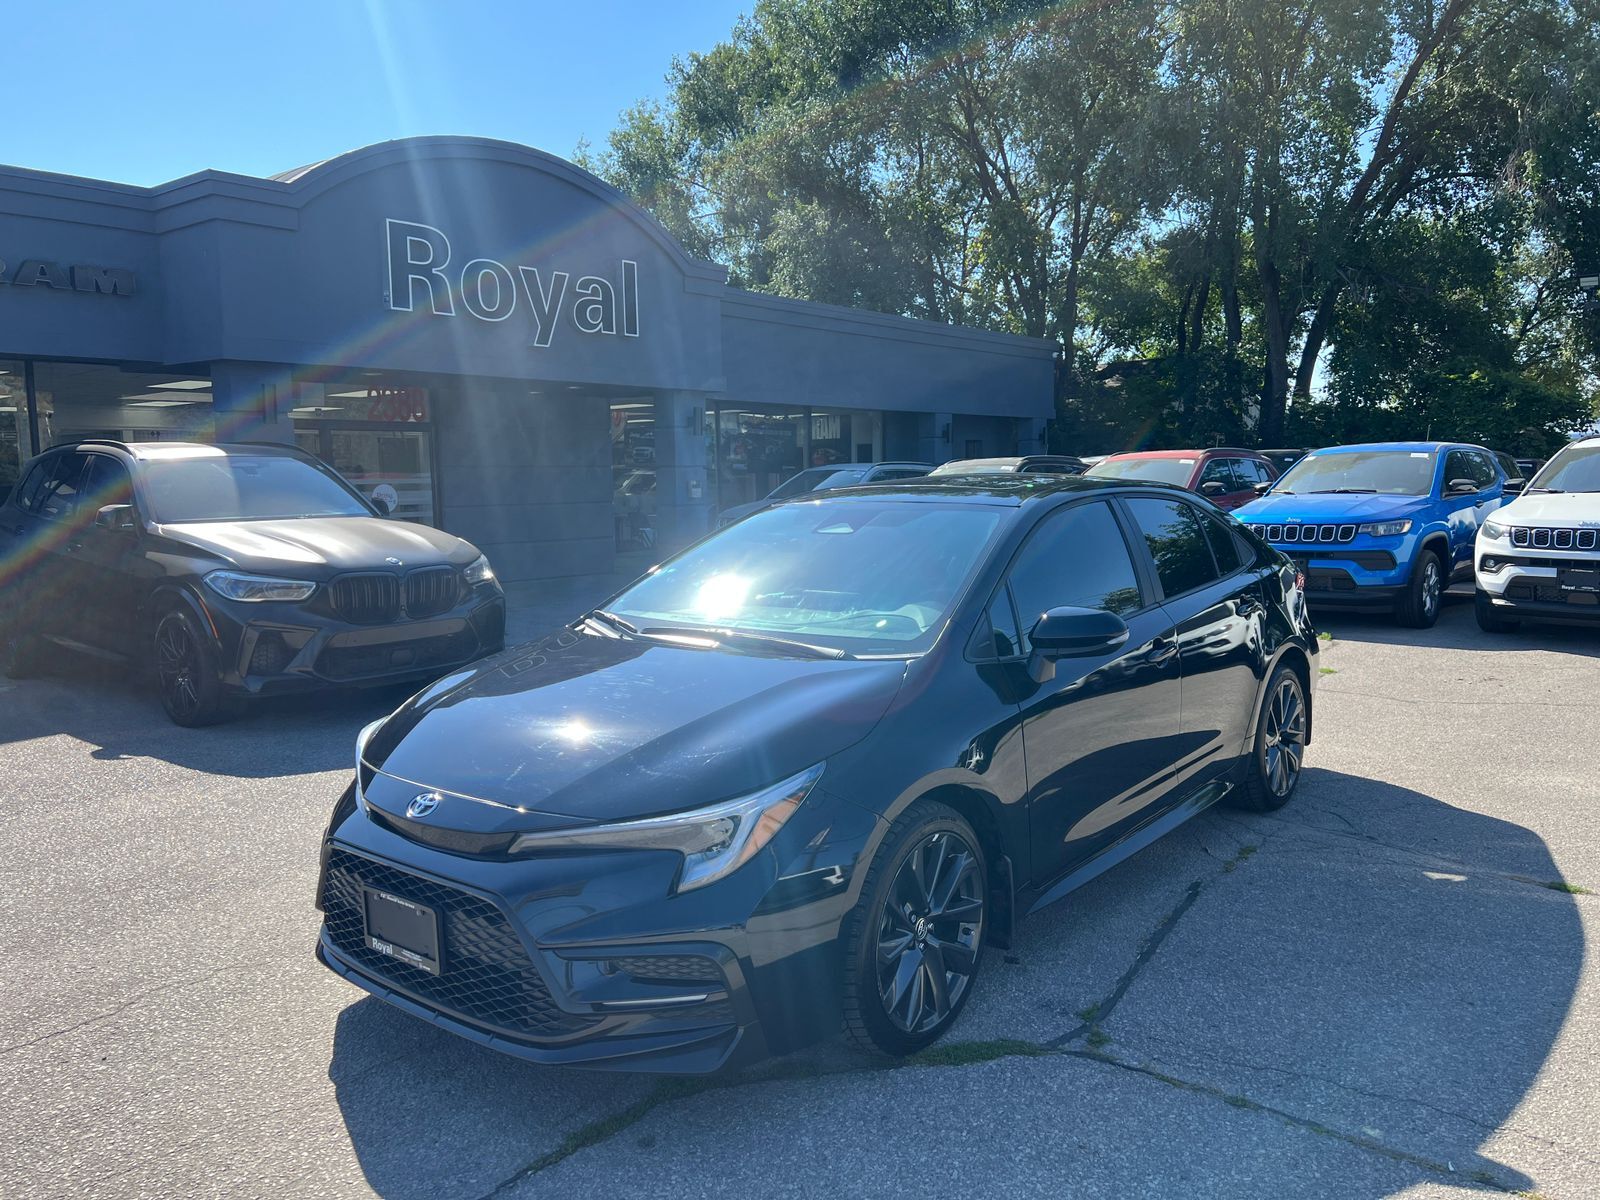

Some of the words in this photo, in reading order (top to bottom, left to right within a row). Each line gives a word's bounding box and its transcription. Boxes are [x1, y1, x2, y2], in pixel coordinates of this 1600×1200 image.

[0, 255, 137, 296] AM
[386, 217, 640, 348] Royal
[372, 938, 393, 954] Royal
